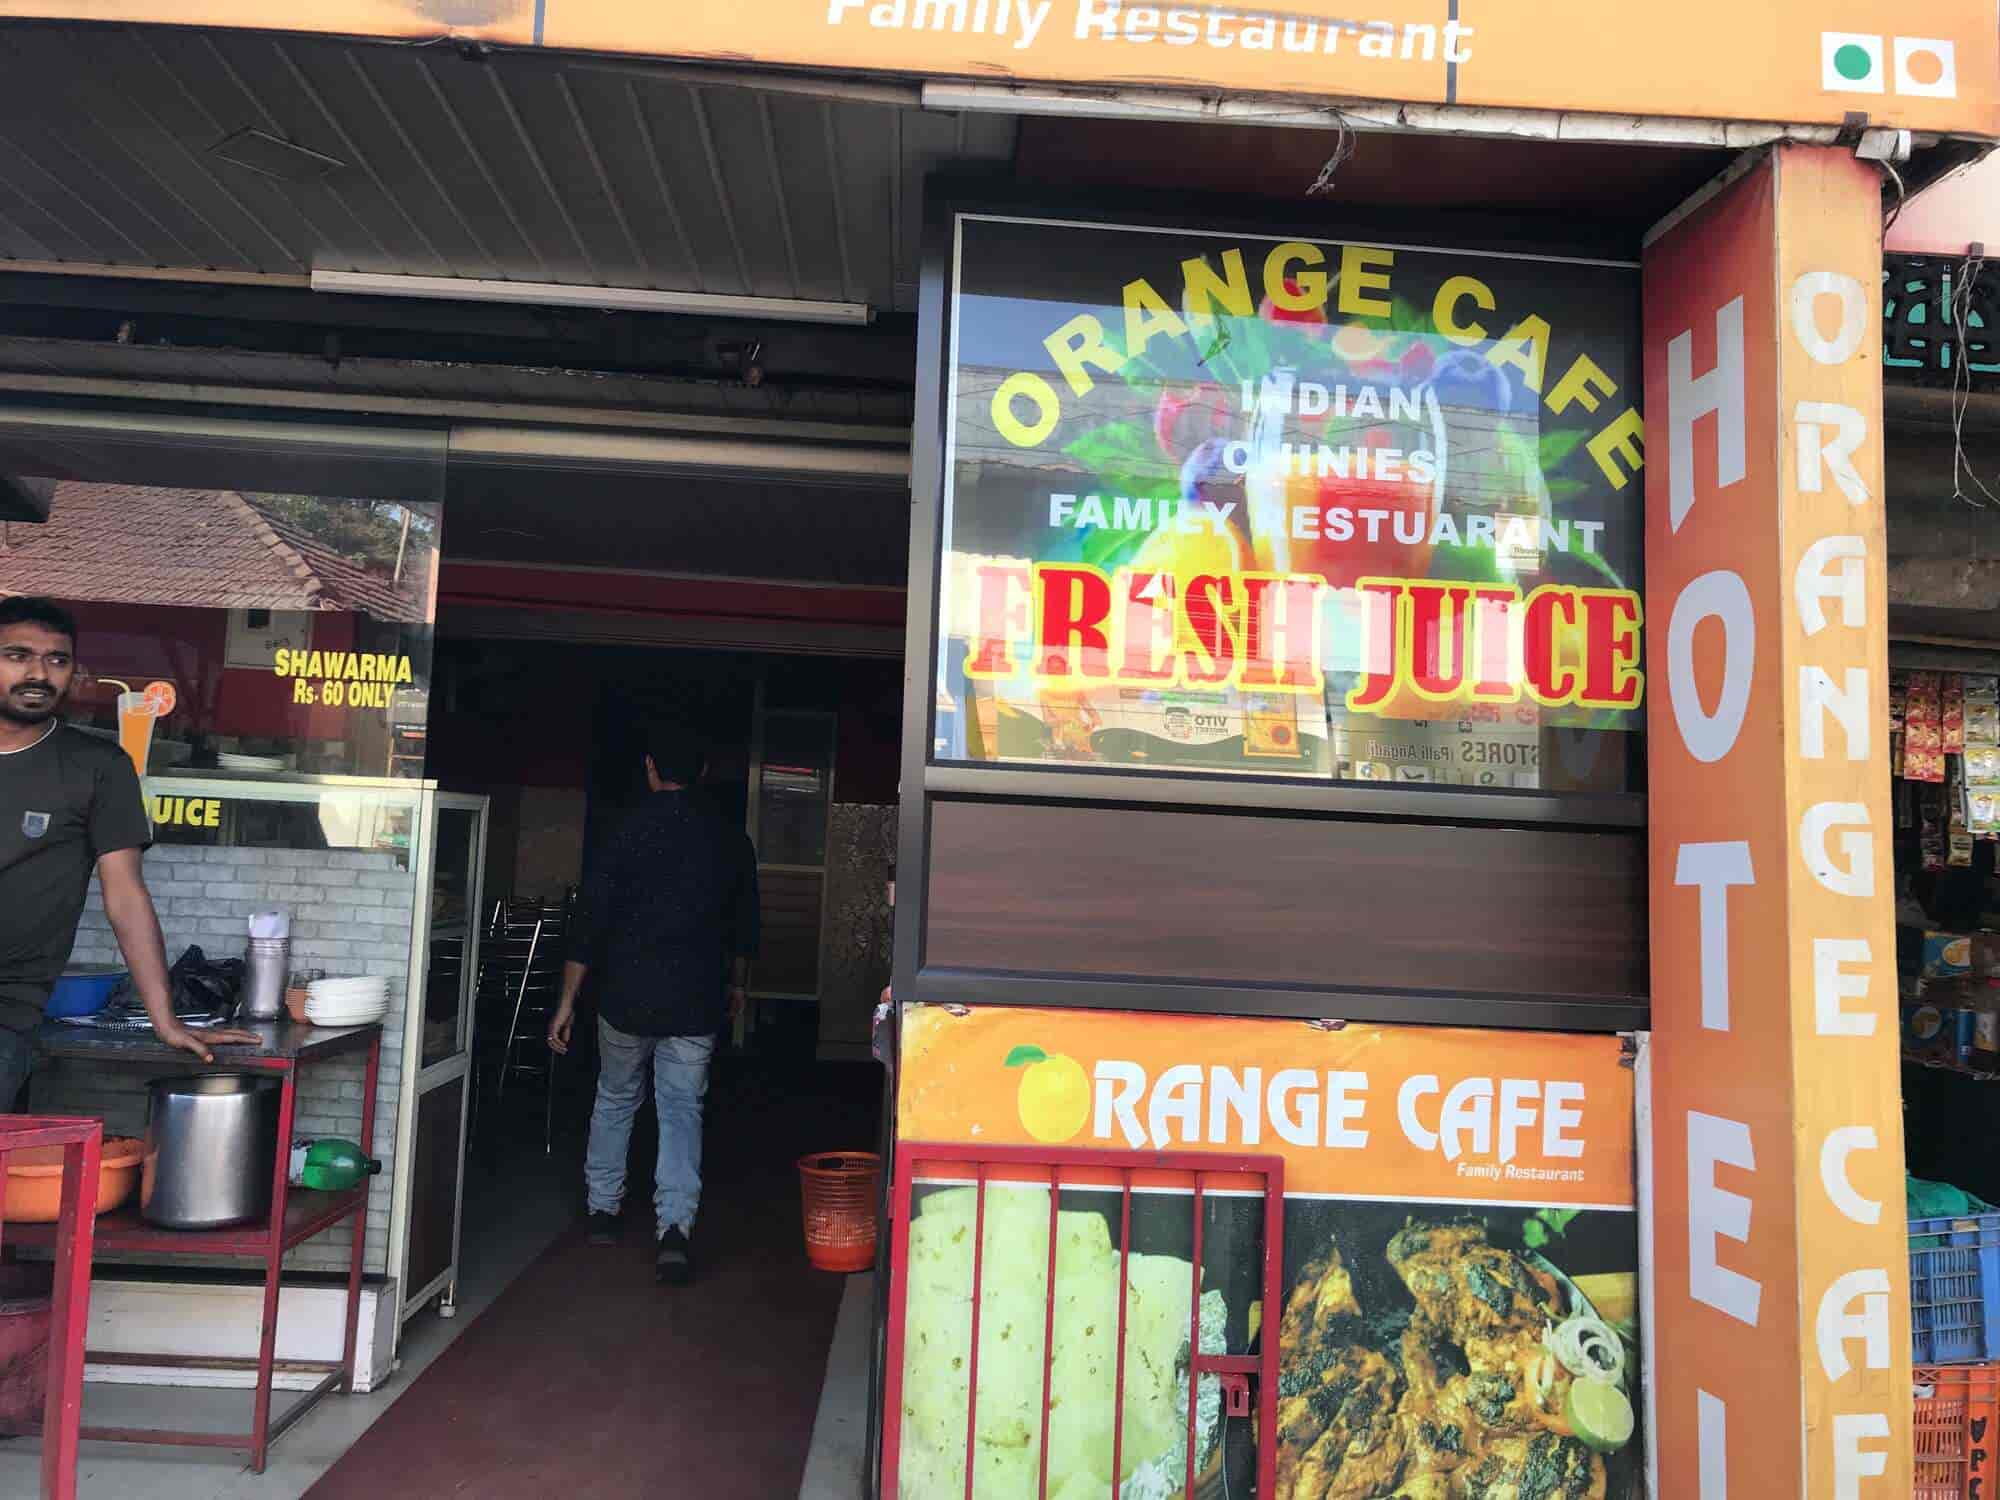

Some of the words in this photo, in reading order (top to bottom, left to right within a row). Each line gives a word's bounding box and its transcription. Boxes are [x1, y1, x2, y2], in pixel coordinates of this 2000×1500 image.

[1072, 0, 1474, 64] Restaurant
[990, 242, 1395, 448] ORANGE
[1431, 275, 1646, 491] CAFE
[1240, 378, 1423, 423] INDIAN
[1049, 493, 1239, 537] FAMILY
[963, 563, 1327, 695] FRESH
[1345, 575, 1646, 713] JUICE
[1789, 271, 1879, 1037] ORANGE
[274, 648, 413, 683] SHAWARMA
[322, 680, 345, 706] 60
[348, 681, 396, 708] ONLY
[144, 797, 221, 827] UICE
[1396, 1073, 1586, 1164] CAFE
[1456, 1161, 1502, 1182] Family
[1503, 1163, 1586, 1182] Restaurant
